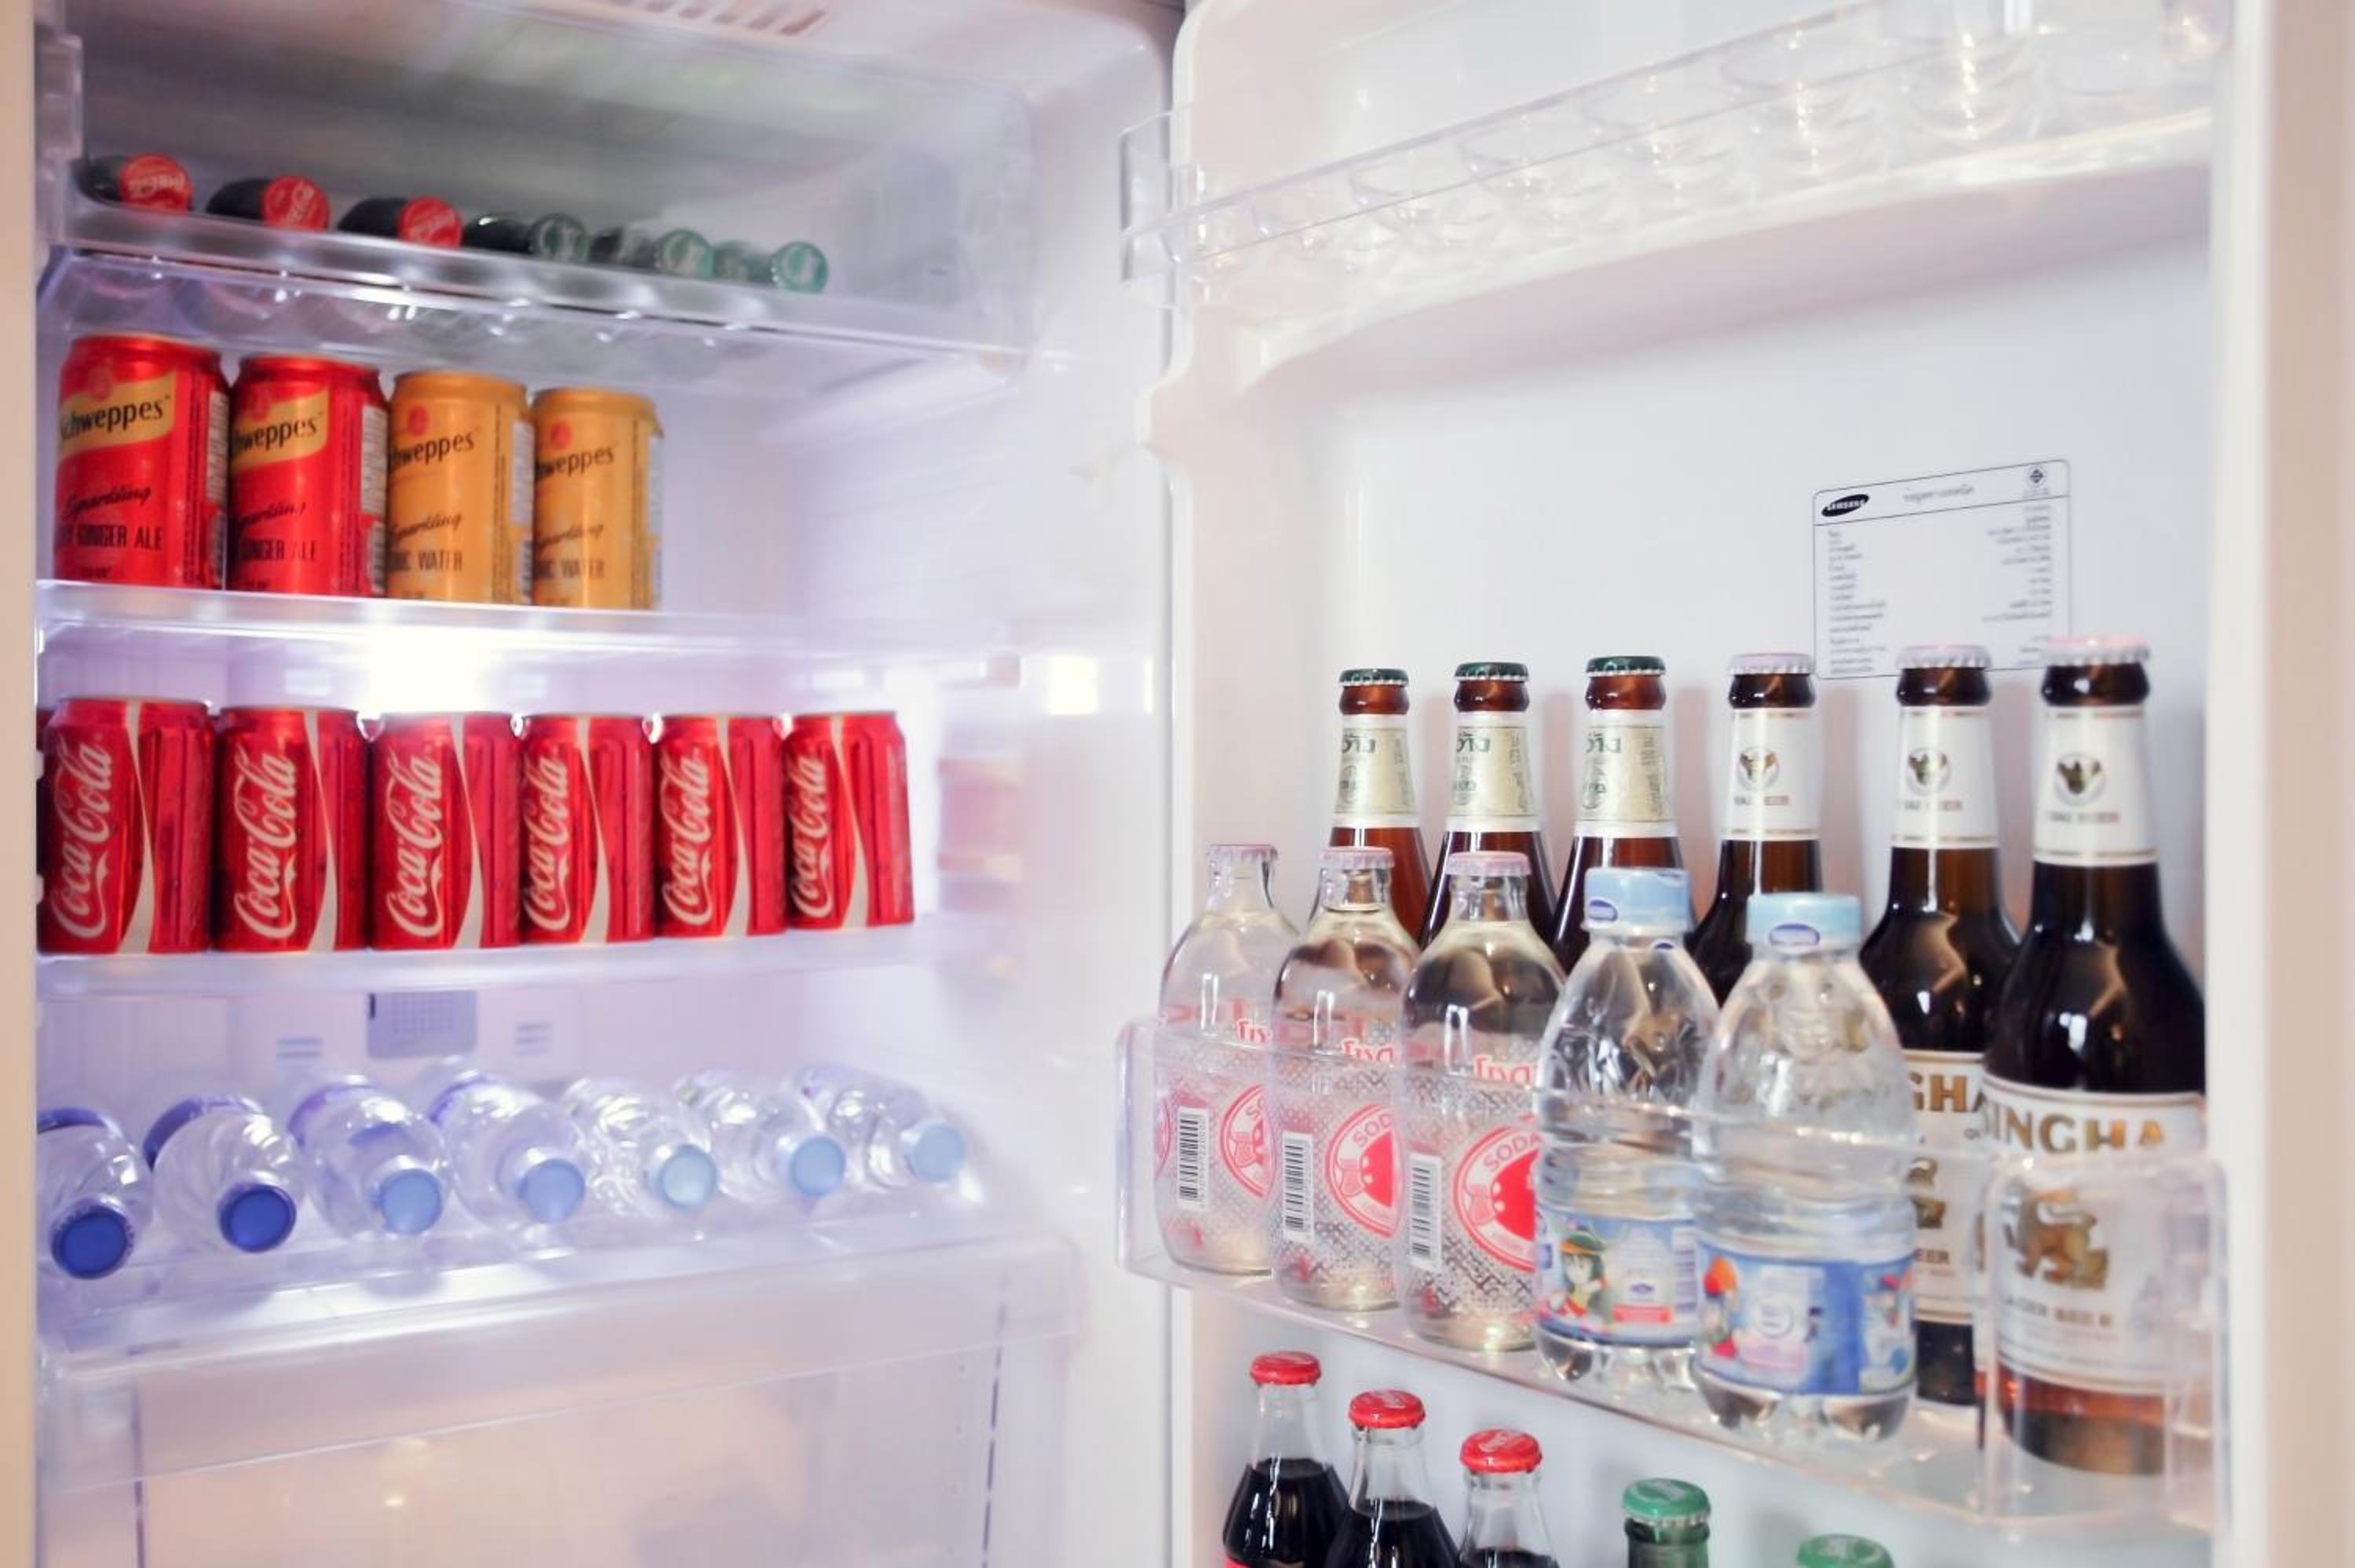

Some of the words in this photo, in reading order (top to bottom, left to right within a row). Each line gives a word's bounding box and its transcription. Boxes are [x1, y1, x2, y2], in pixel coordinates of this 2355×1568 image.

[61, 400, 163, 439] chweppes
[133, 527, 162, 550] ALE
[51, 735, 112, 938] Coca-Cola
[234, 744, 298, 939] Coca-Cola
[386, 749, 444, 938] Coca-Cola
[523, 752, 571, 932] Coca-Cola
[660, 750, 712, 926] Coca-Cola
[787, 755, 834, 918] Coca-Cola
[1484, 1132, 1543, 1171] SODA
